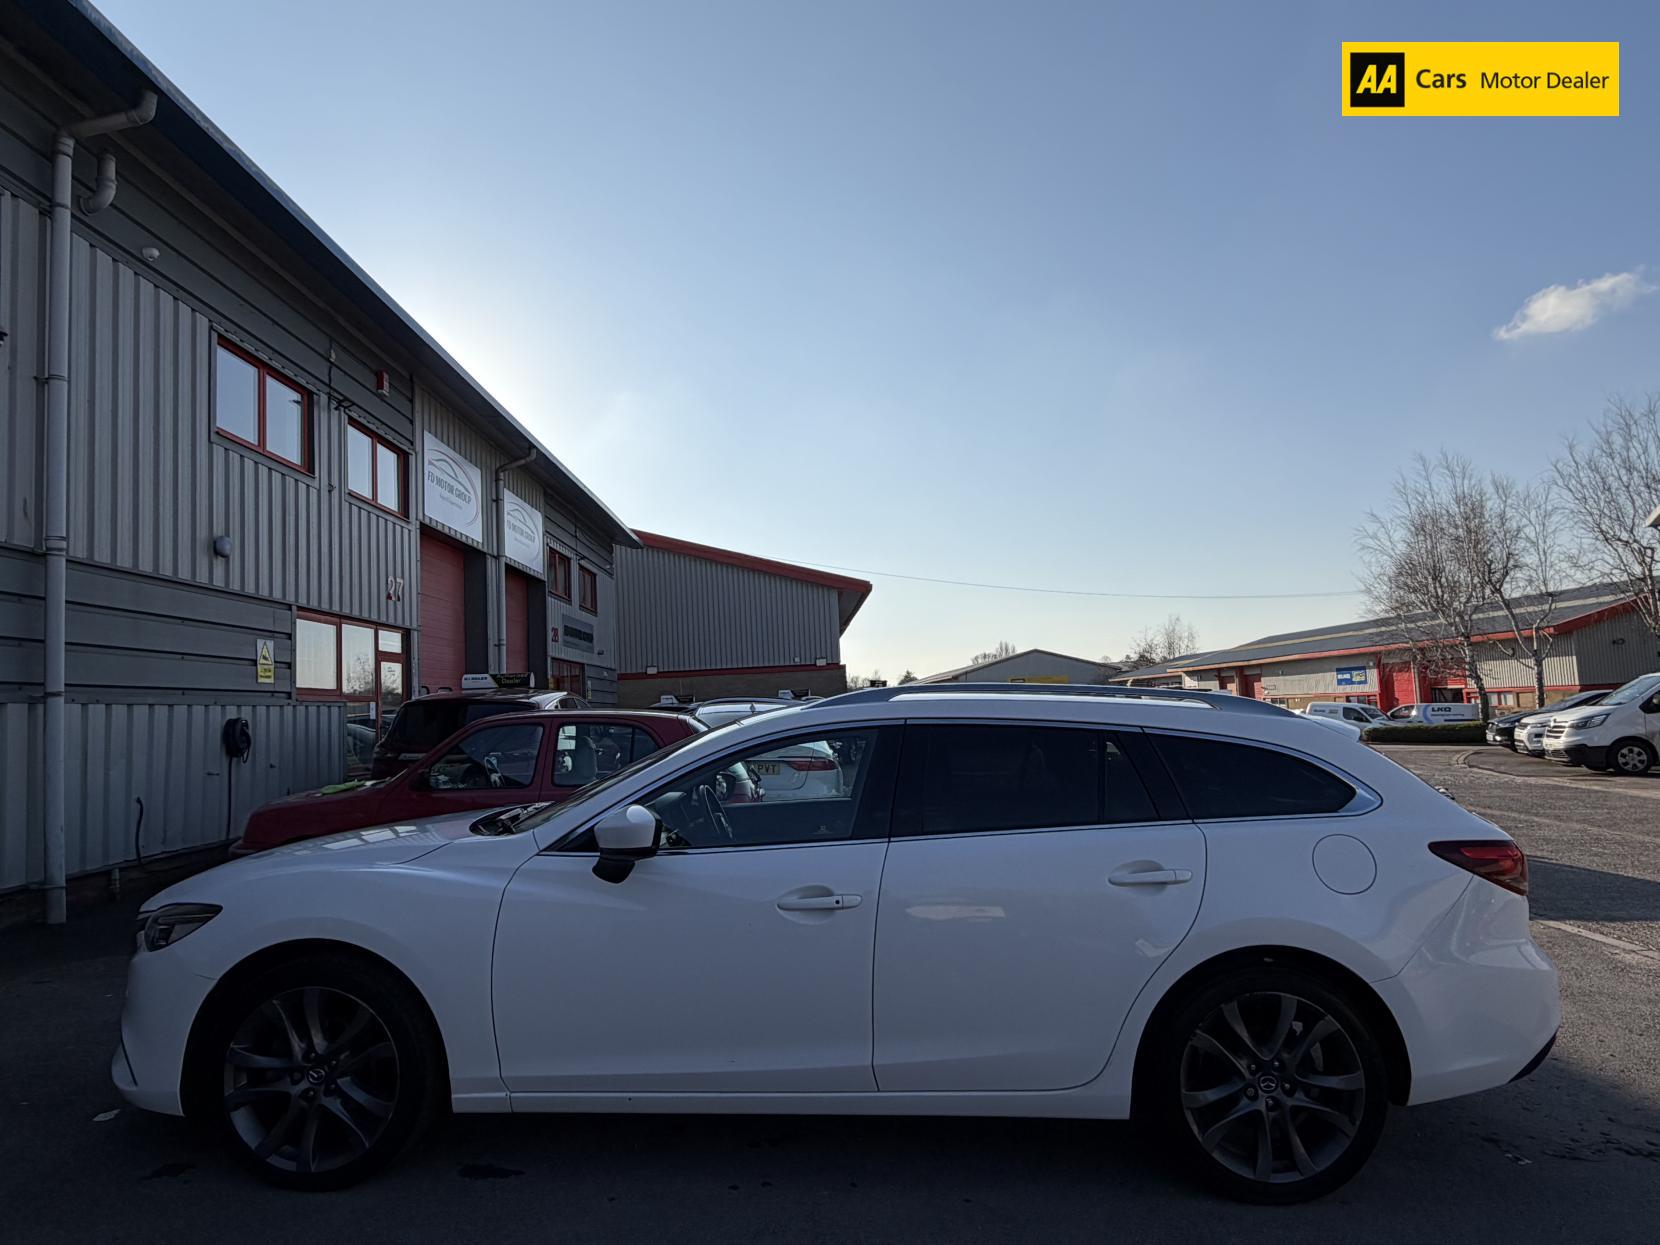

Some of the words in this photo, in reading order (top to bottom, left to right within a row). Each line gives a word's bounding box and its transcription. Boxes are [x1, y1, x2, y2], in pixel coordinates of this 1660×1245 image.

[428, 470, 435, 483] FD
[435, 476, 455, 496] MOTOR
[455, 487, 472, 505] GROUP
[386, 575, 404, 602] 27
[551, 626, 559, 643] 28
[757, 764, 777, 774] PVT
